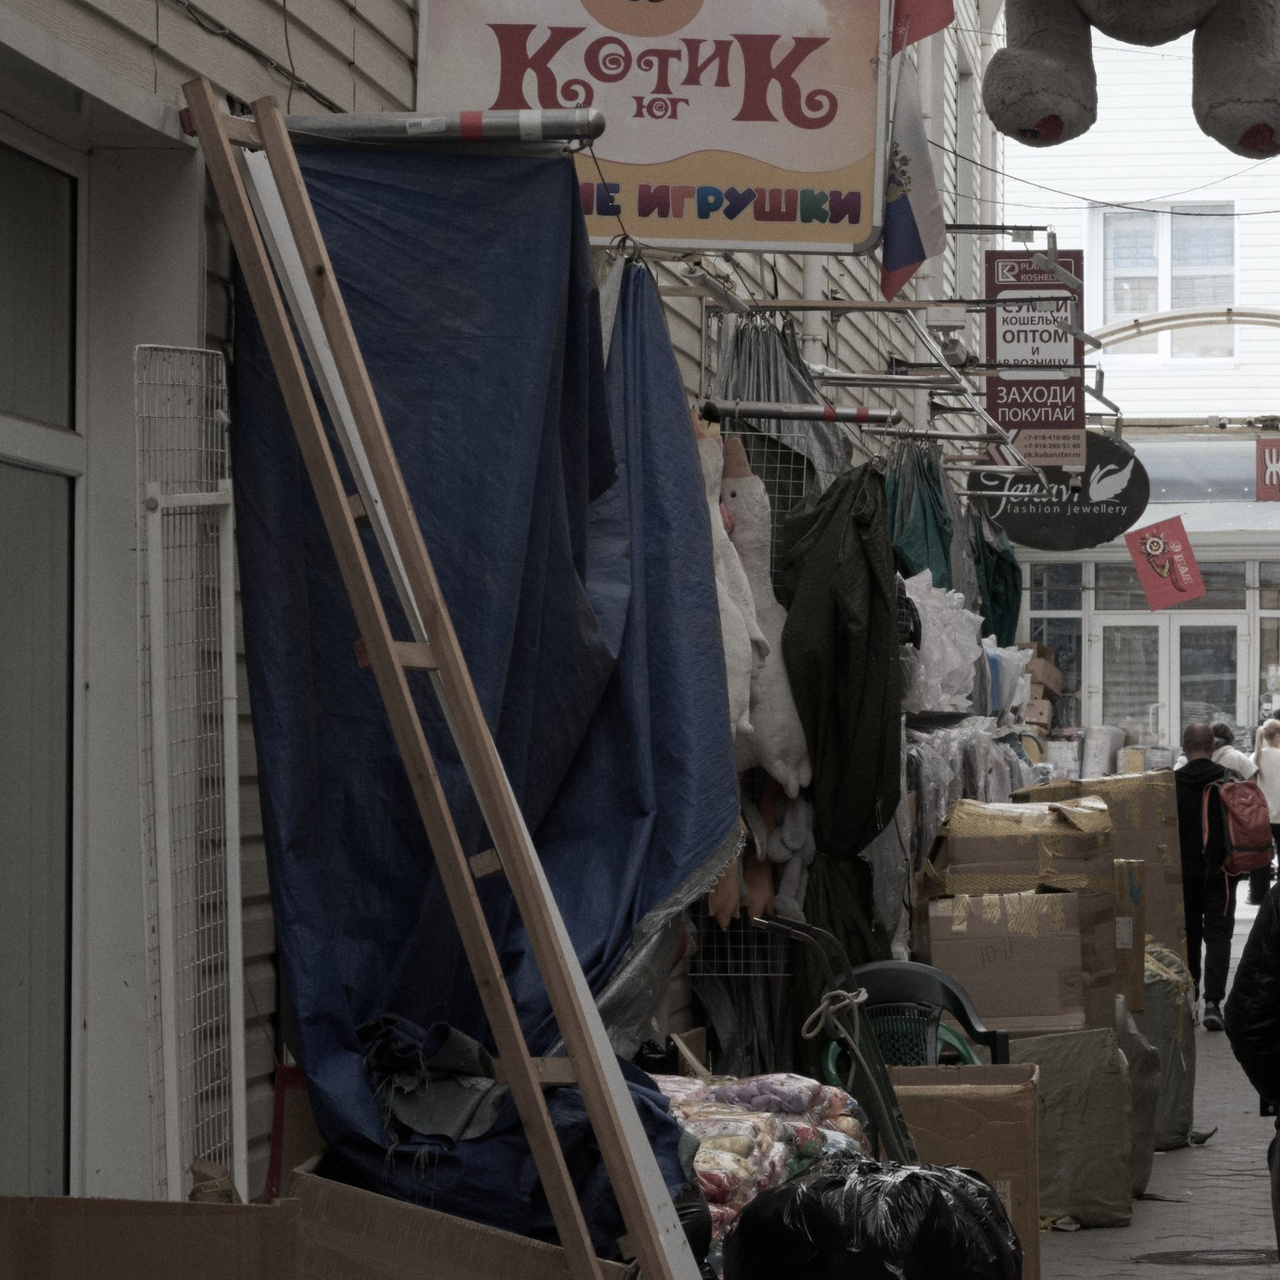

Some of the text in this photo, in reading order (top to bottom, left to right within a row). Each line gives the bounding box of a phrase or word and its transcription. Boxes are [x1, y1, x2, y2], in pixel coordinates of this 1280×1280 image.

[637, 184, 862, 225] ИГРУШКИ
[1002, 316, 1068, 326] КОШЕЛЬКИ
[1002, 330, 1068, 344] ОПТОМ
[1031, 346, 1040, 356] И
[997, 386, 1076, 406] ЗАХОДИ
[998, 406, 1075, 422] ПОКУПАЙ
[1024, 451, 1081, 459] pk.kubanstar.ru
[1006, 503, 1060, 514] fashion
[1066, 503, 1128, 516] jewellery
